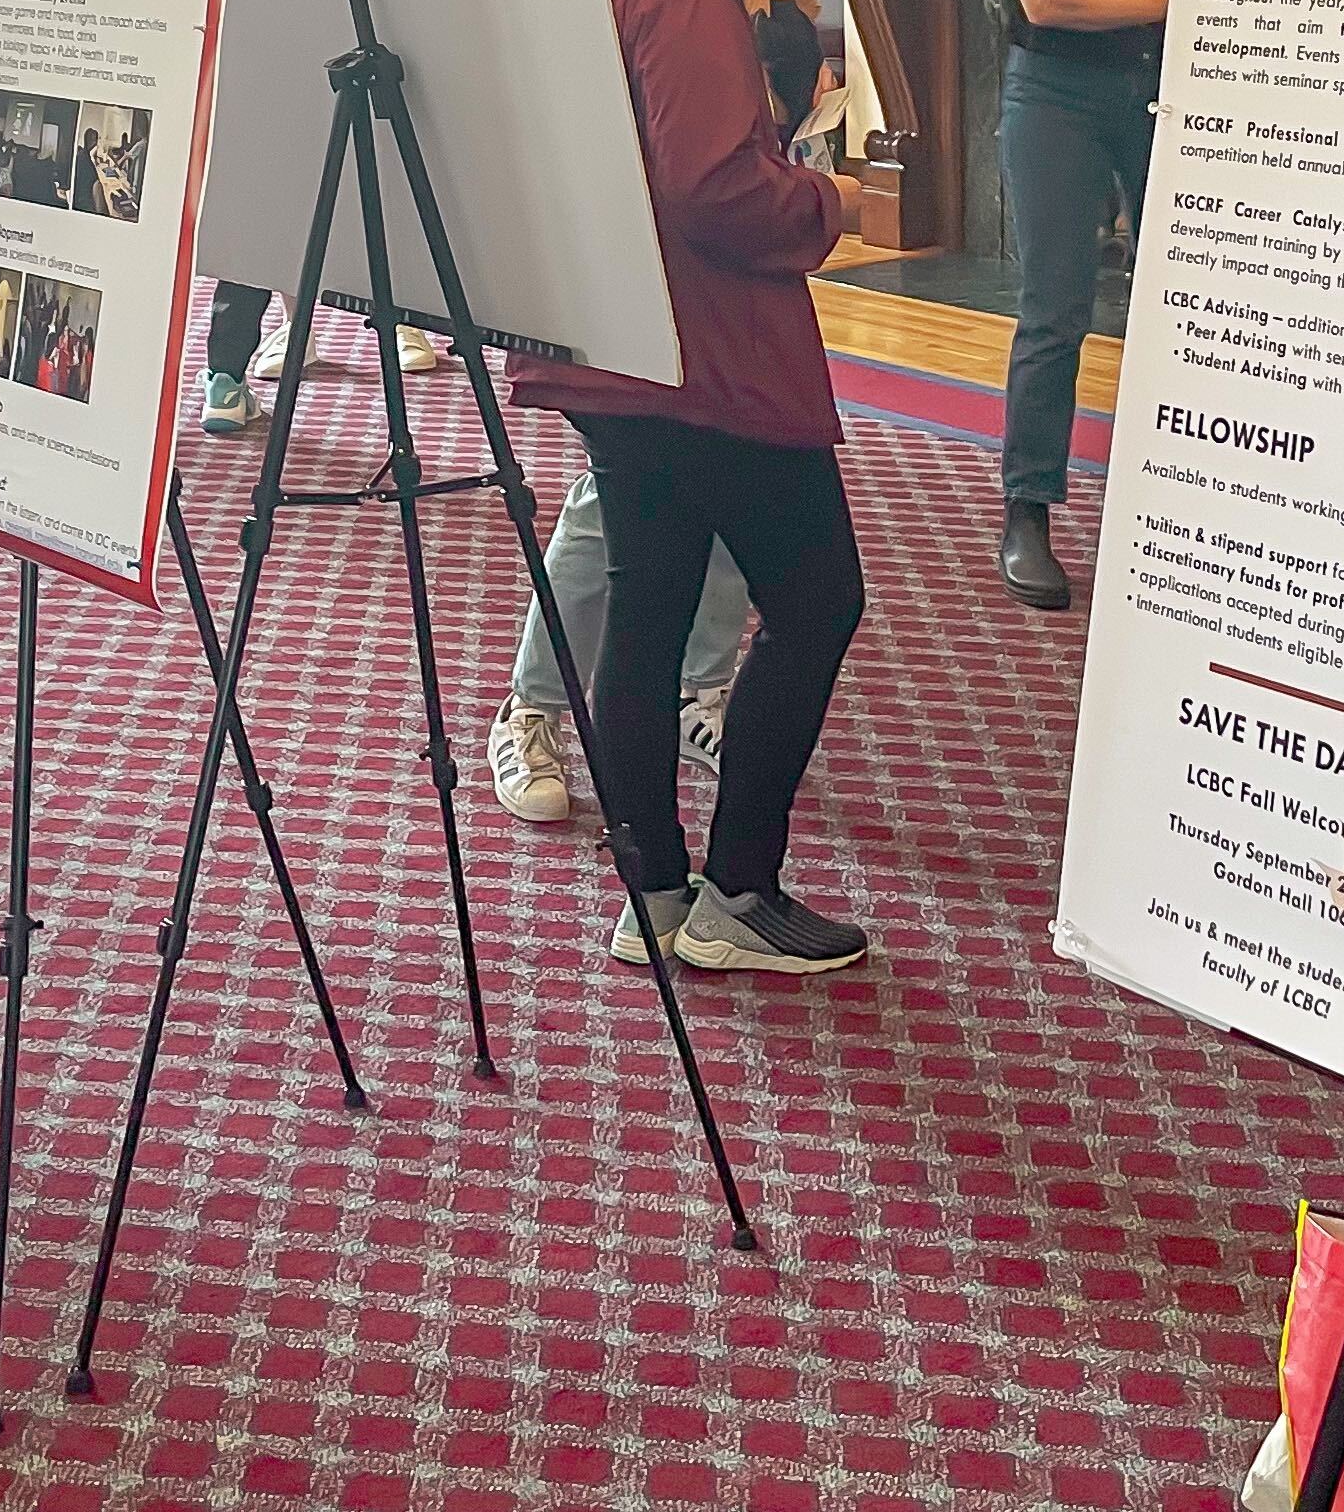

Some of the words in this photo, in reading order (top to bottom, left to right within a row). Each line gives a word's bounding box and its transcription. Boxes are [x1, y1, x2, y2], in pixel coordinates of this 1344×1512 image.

[1189, 61, 1238, 82] lunches
[1241, 68, 1269, 85] with
[1273, 73, 1329, 90] seminar
[1180, 145, 1258, 165] competition
[1261, 149, 1293, 169] held
[1167, 245, 1218, 272] directly
[1221, 254, 1270, 276] impact
[1273, 267, 1332, 291] ongoing
[1182, 347, 1236, 373] Student
[1239, 359, 1307, 391] Advising
[1312, 376, 1342, 394] with
[1156, 403, 1315, 463] FELLOWSHIP
[1141, 458, 1208, 488] Available
[1212, 476, 1226, 492] to
[1229, 483, 1288, 508] students
[1142, 541, 1236, 584] discretionary
[1239, 566, 1281, 593] funds
[1286, 579, 1308, 600] for
[1178, 697, 1247, 744] SAVE
[1256, 720, 1307, 764] THE
[1186, 763, 1235, 798] LCBC
[1240, 781, 1276, 813] Fall
[1169, 812, 1241, 859] Thursday
[1245, 841, 1332, 888] September
[1213, 861, 1273, 899] Gordon
[1279, 884, 1313, 914] Hall
[1202, 950, 1256, 992] faculty
[1260, 979, 1280, 997] of
[1282, 983, 1332, 1019] LCBC!
